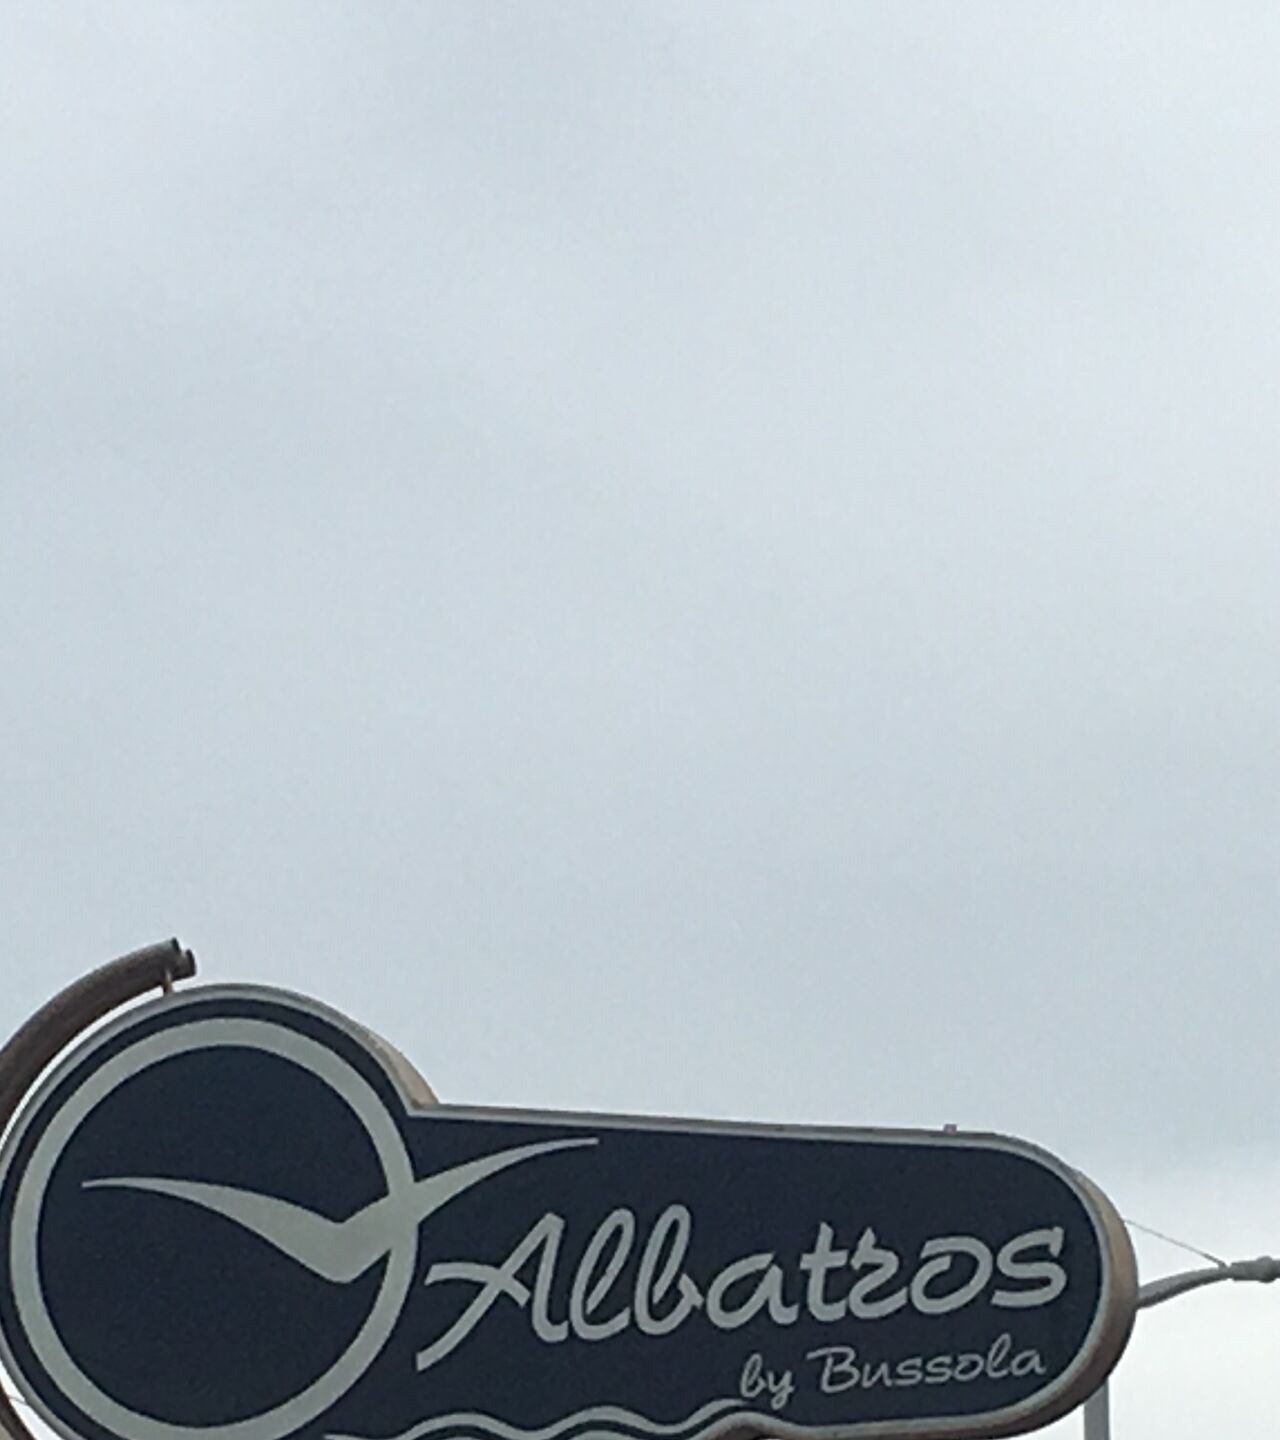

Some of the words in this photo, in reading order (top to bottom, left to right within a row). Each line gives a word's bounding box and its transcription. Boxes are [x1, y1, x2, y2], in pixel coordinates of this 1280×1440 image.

[417, 1204, 1067, 1371] Albatros
[740, 1352, 795, 1409] by
[807, 1333, 1047, 1394] Bussola
